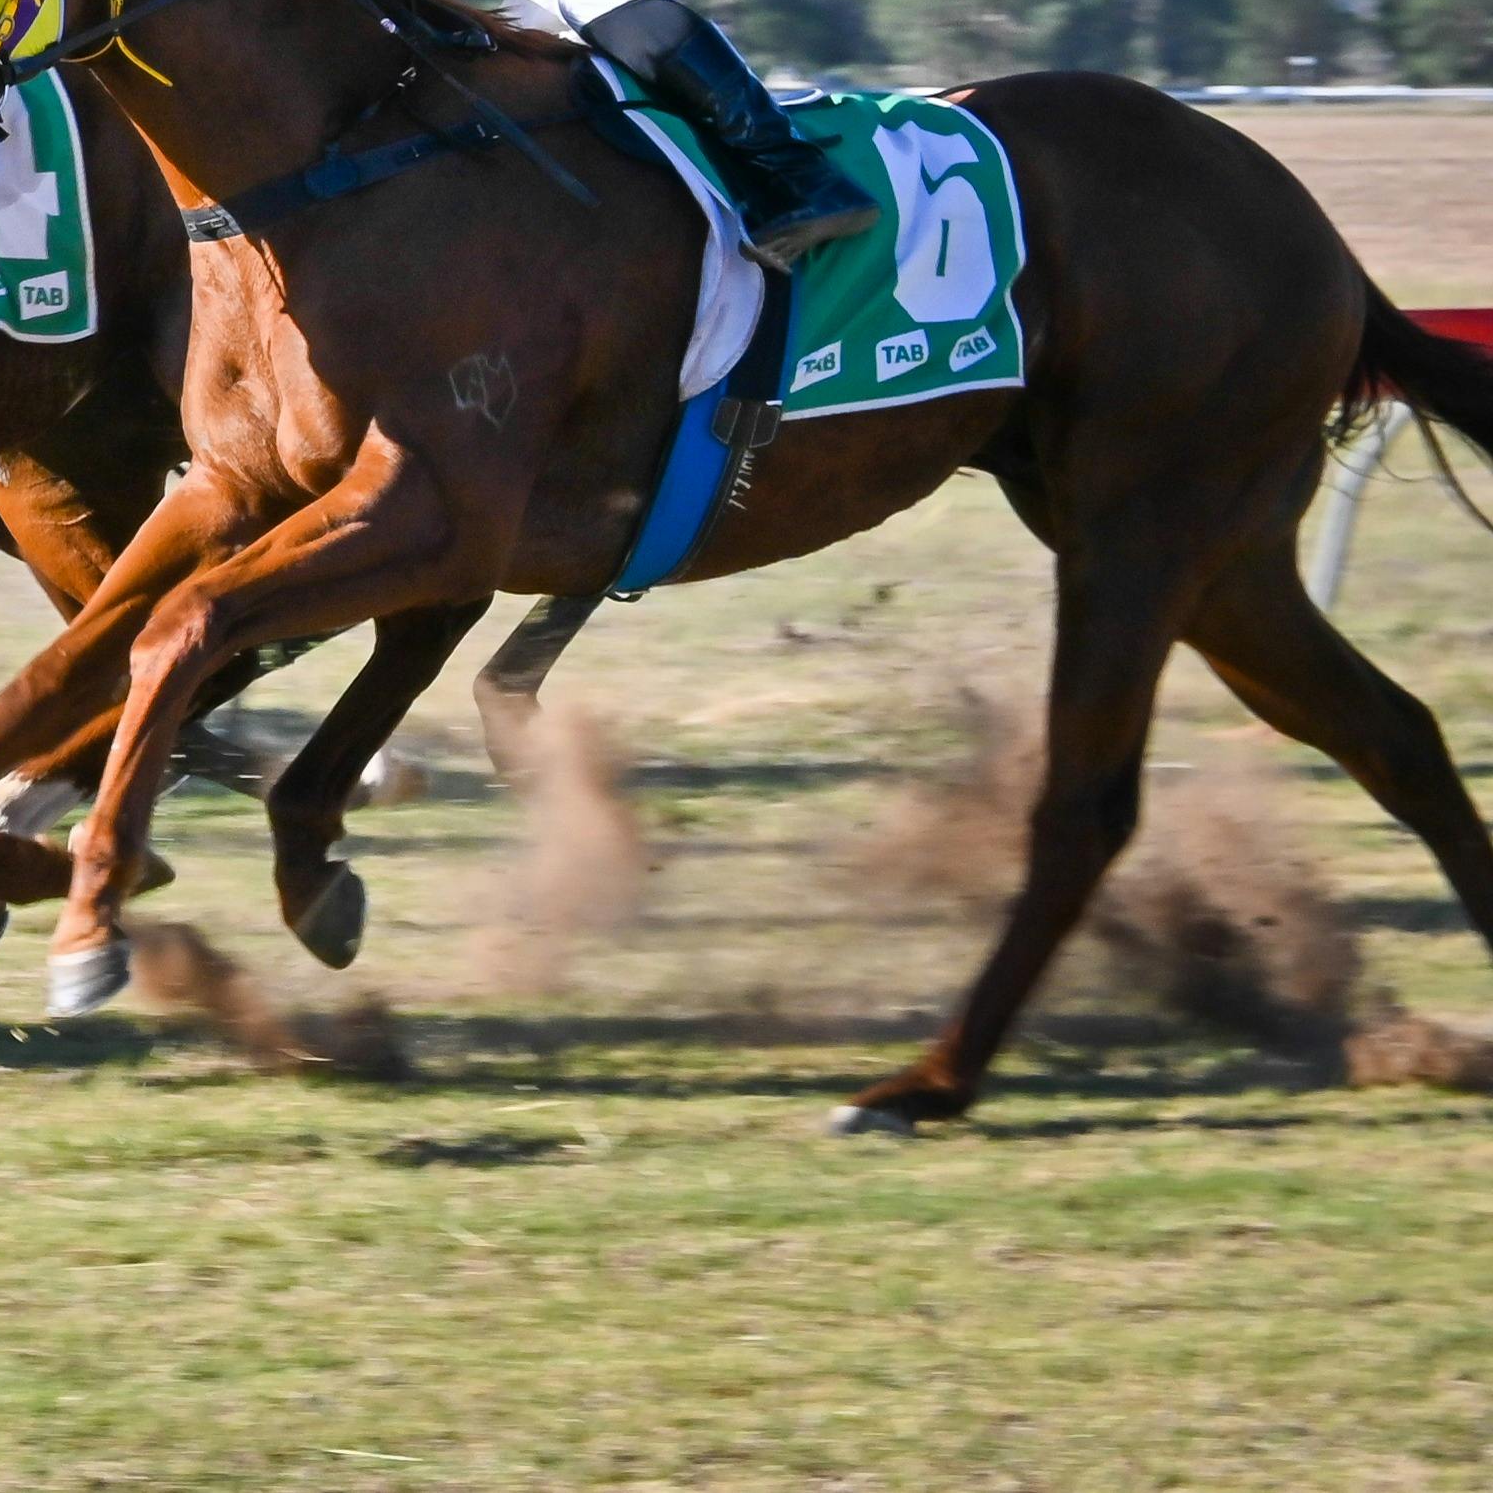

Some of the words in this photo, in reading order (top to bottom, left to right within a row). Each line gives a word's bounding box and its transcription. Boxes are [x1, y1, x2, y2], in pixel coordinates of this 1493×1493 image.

[872, 119, 997, 323] 6
[23, 286, 64, 307] TAB
[881, 343, 925, 364] TAB
